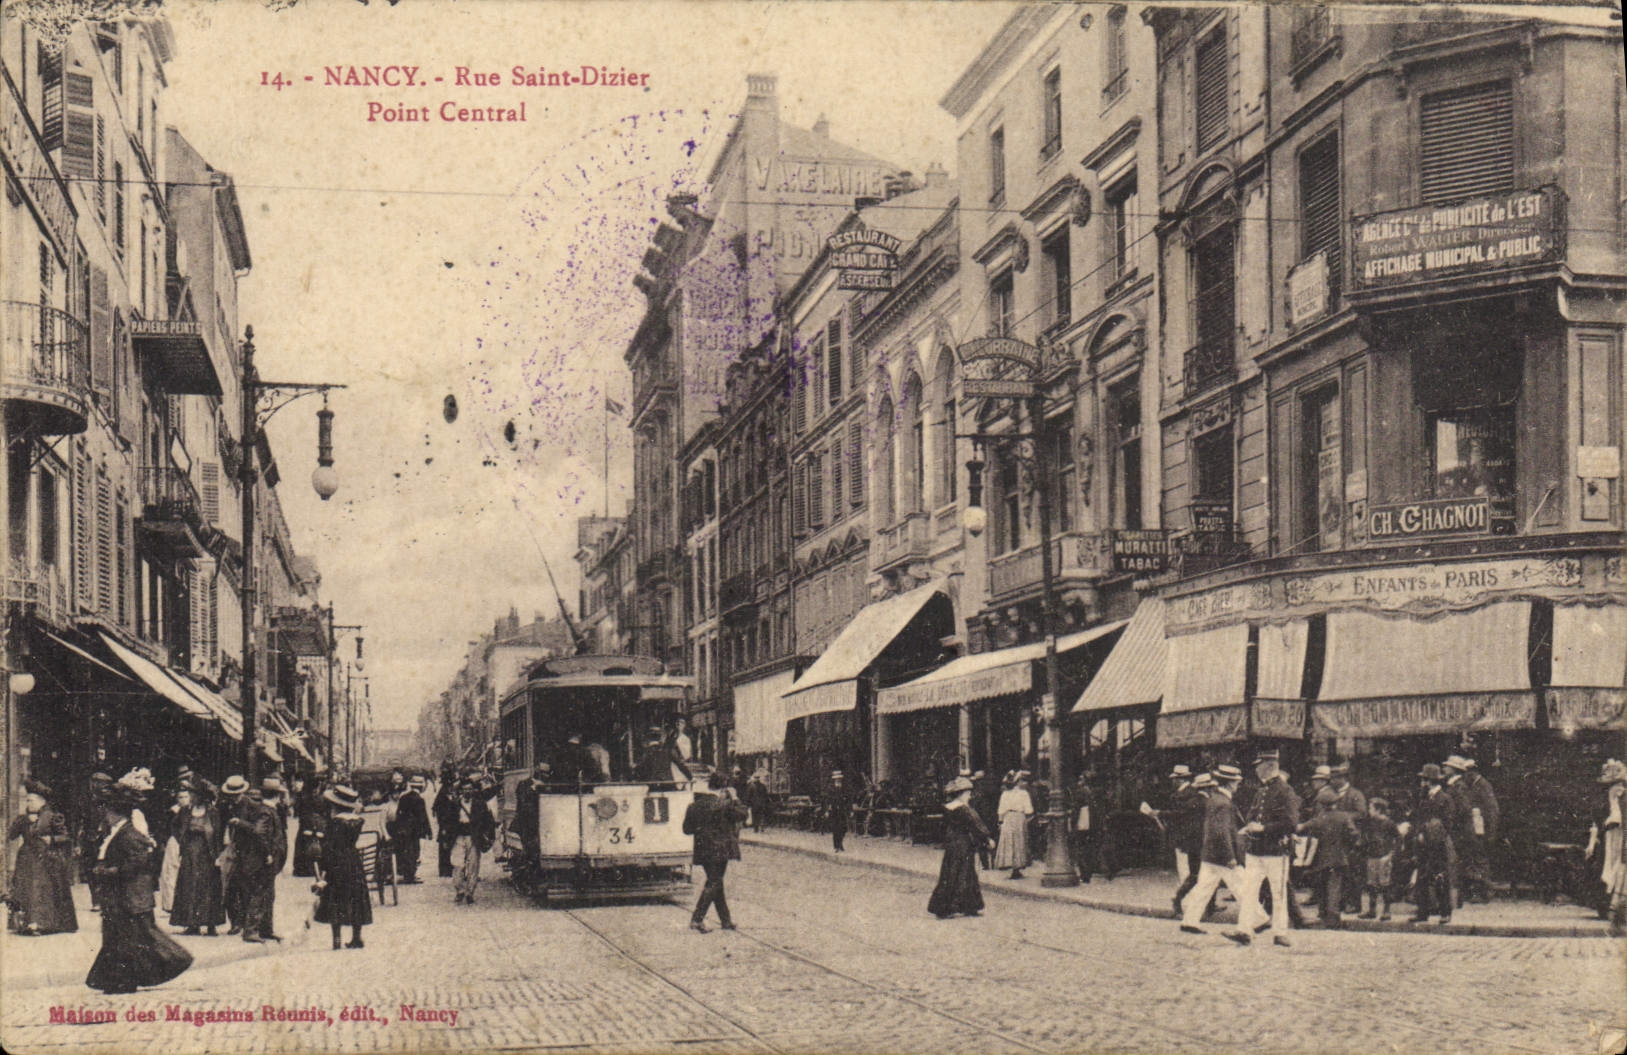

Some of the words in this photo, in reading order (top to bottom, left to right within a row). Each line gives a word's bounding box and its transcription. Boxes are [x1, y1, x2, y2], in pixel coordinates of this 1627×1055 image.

[756, 158, 882, 197] VXELAIRE
[1491, 203, 1505, 224] de
[1507, 195, 1541, 220] L'EST
[829, 230, 901, 251] RESTAURANT
[1411, 230, 1470, 250] WALTER
[832, 252, 867, 268] GRAND
[1364, 253, 1422, 278] AFFICHAGE
[1425, 244, 1485, 270] MUNICIPAL
[1486, 246, 1496, 261] &
[131, 321, 167, 333] PAPIERS
[170, 321, 202, 335] PEINTS
[1370, 512, 1399, 536] CH.
[1399, 503, 1487, 533] CHAGNOT
[1114, 540, 1166, 555] MURATTI
[1121, 557, 1161, 571] TABAC
[1353, 574, 1428, 595] ENFANTS
[1445, 568, 1499, 589] PARIS
[608, 827, 636, 845] 34
